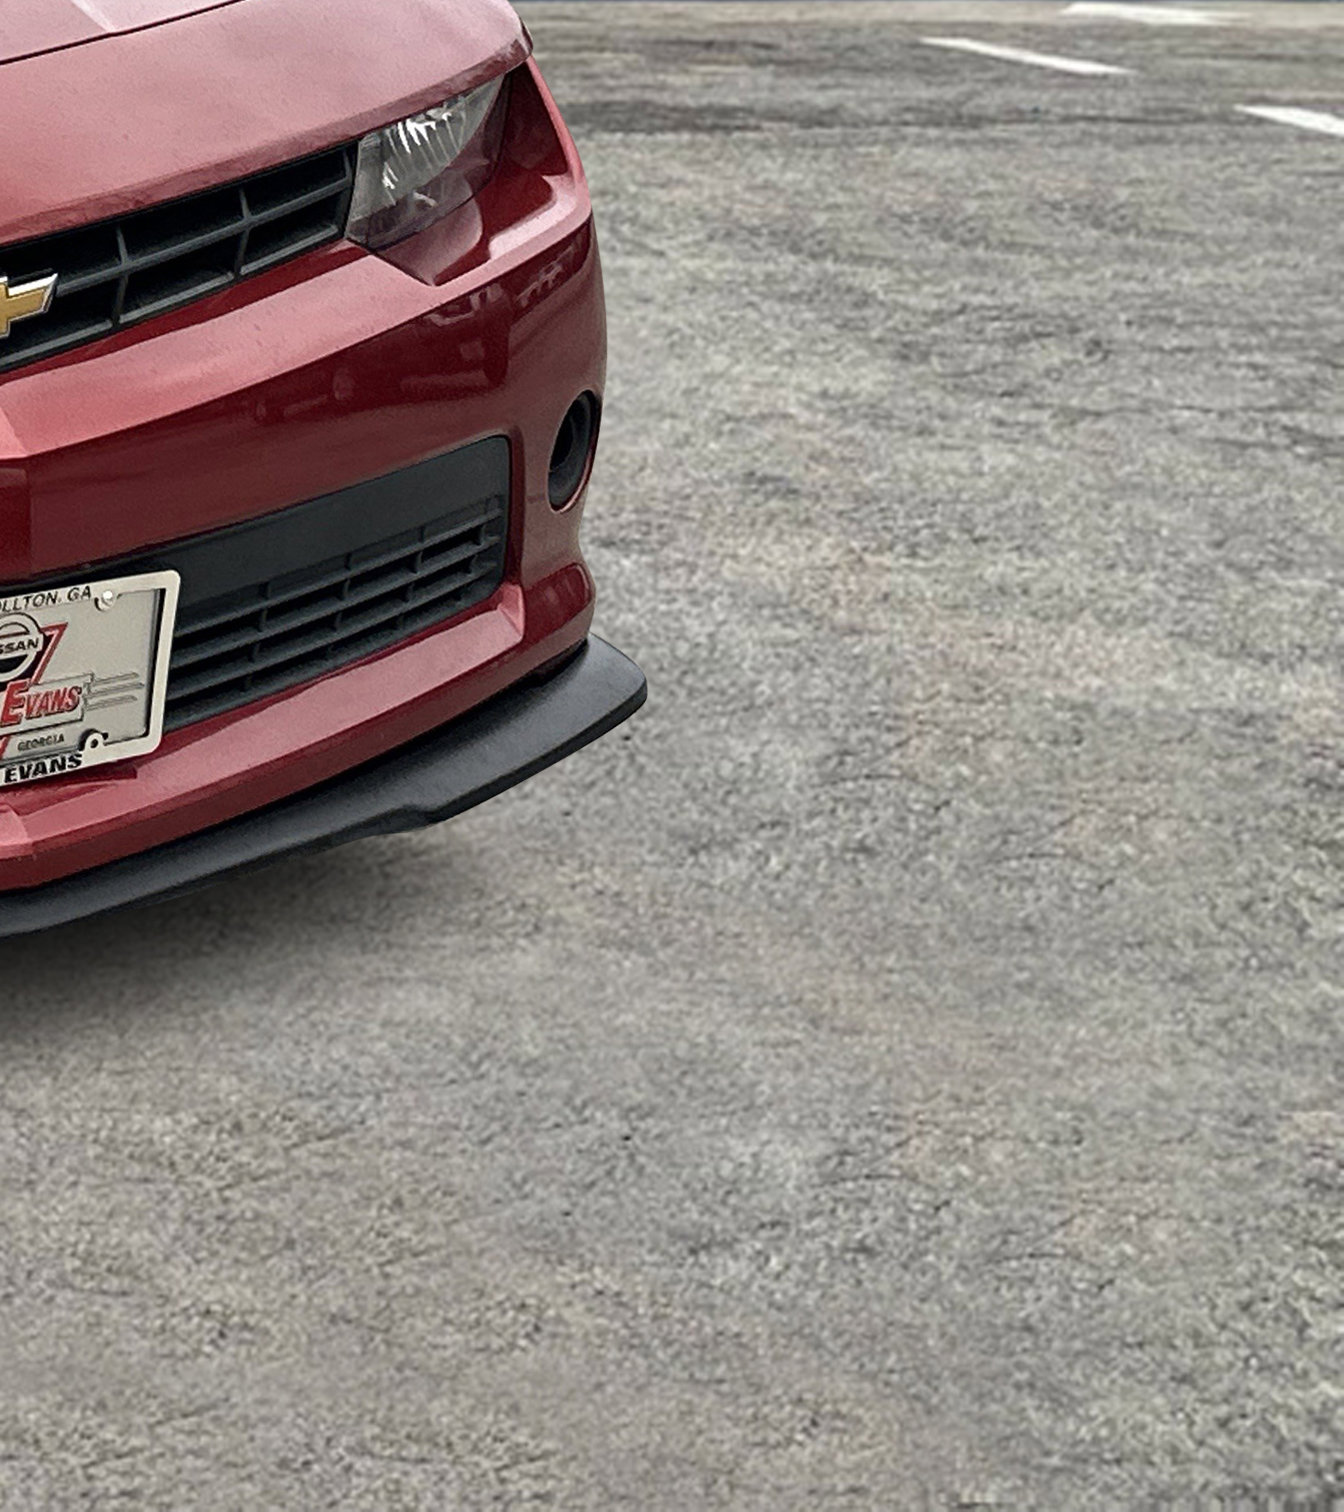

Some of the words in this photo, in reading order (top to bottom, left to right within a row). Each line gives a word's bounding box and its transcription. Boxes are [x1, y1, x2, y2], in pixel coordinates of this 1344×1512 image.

[66, 585, 92, 602] GA
[17, 733, 66, 752] GEORGIA
[3, 752, 83, 784] EVANS
